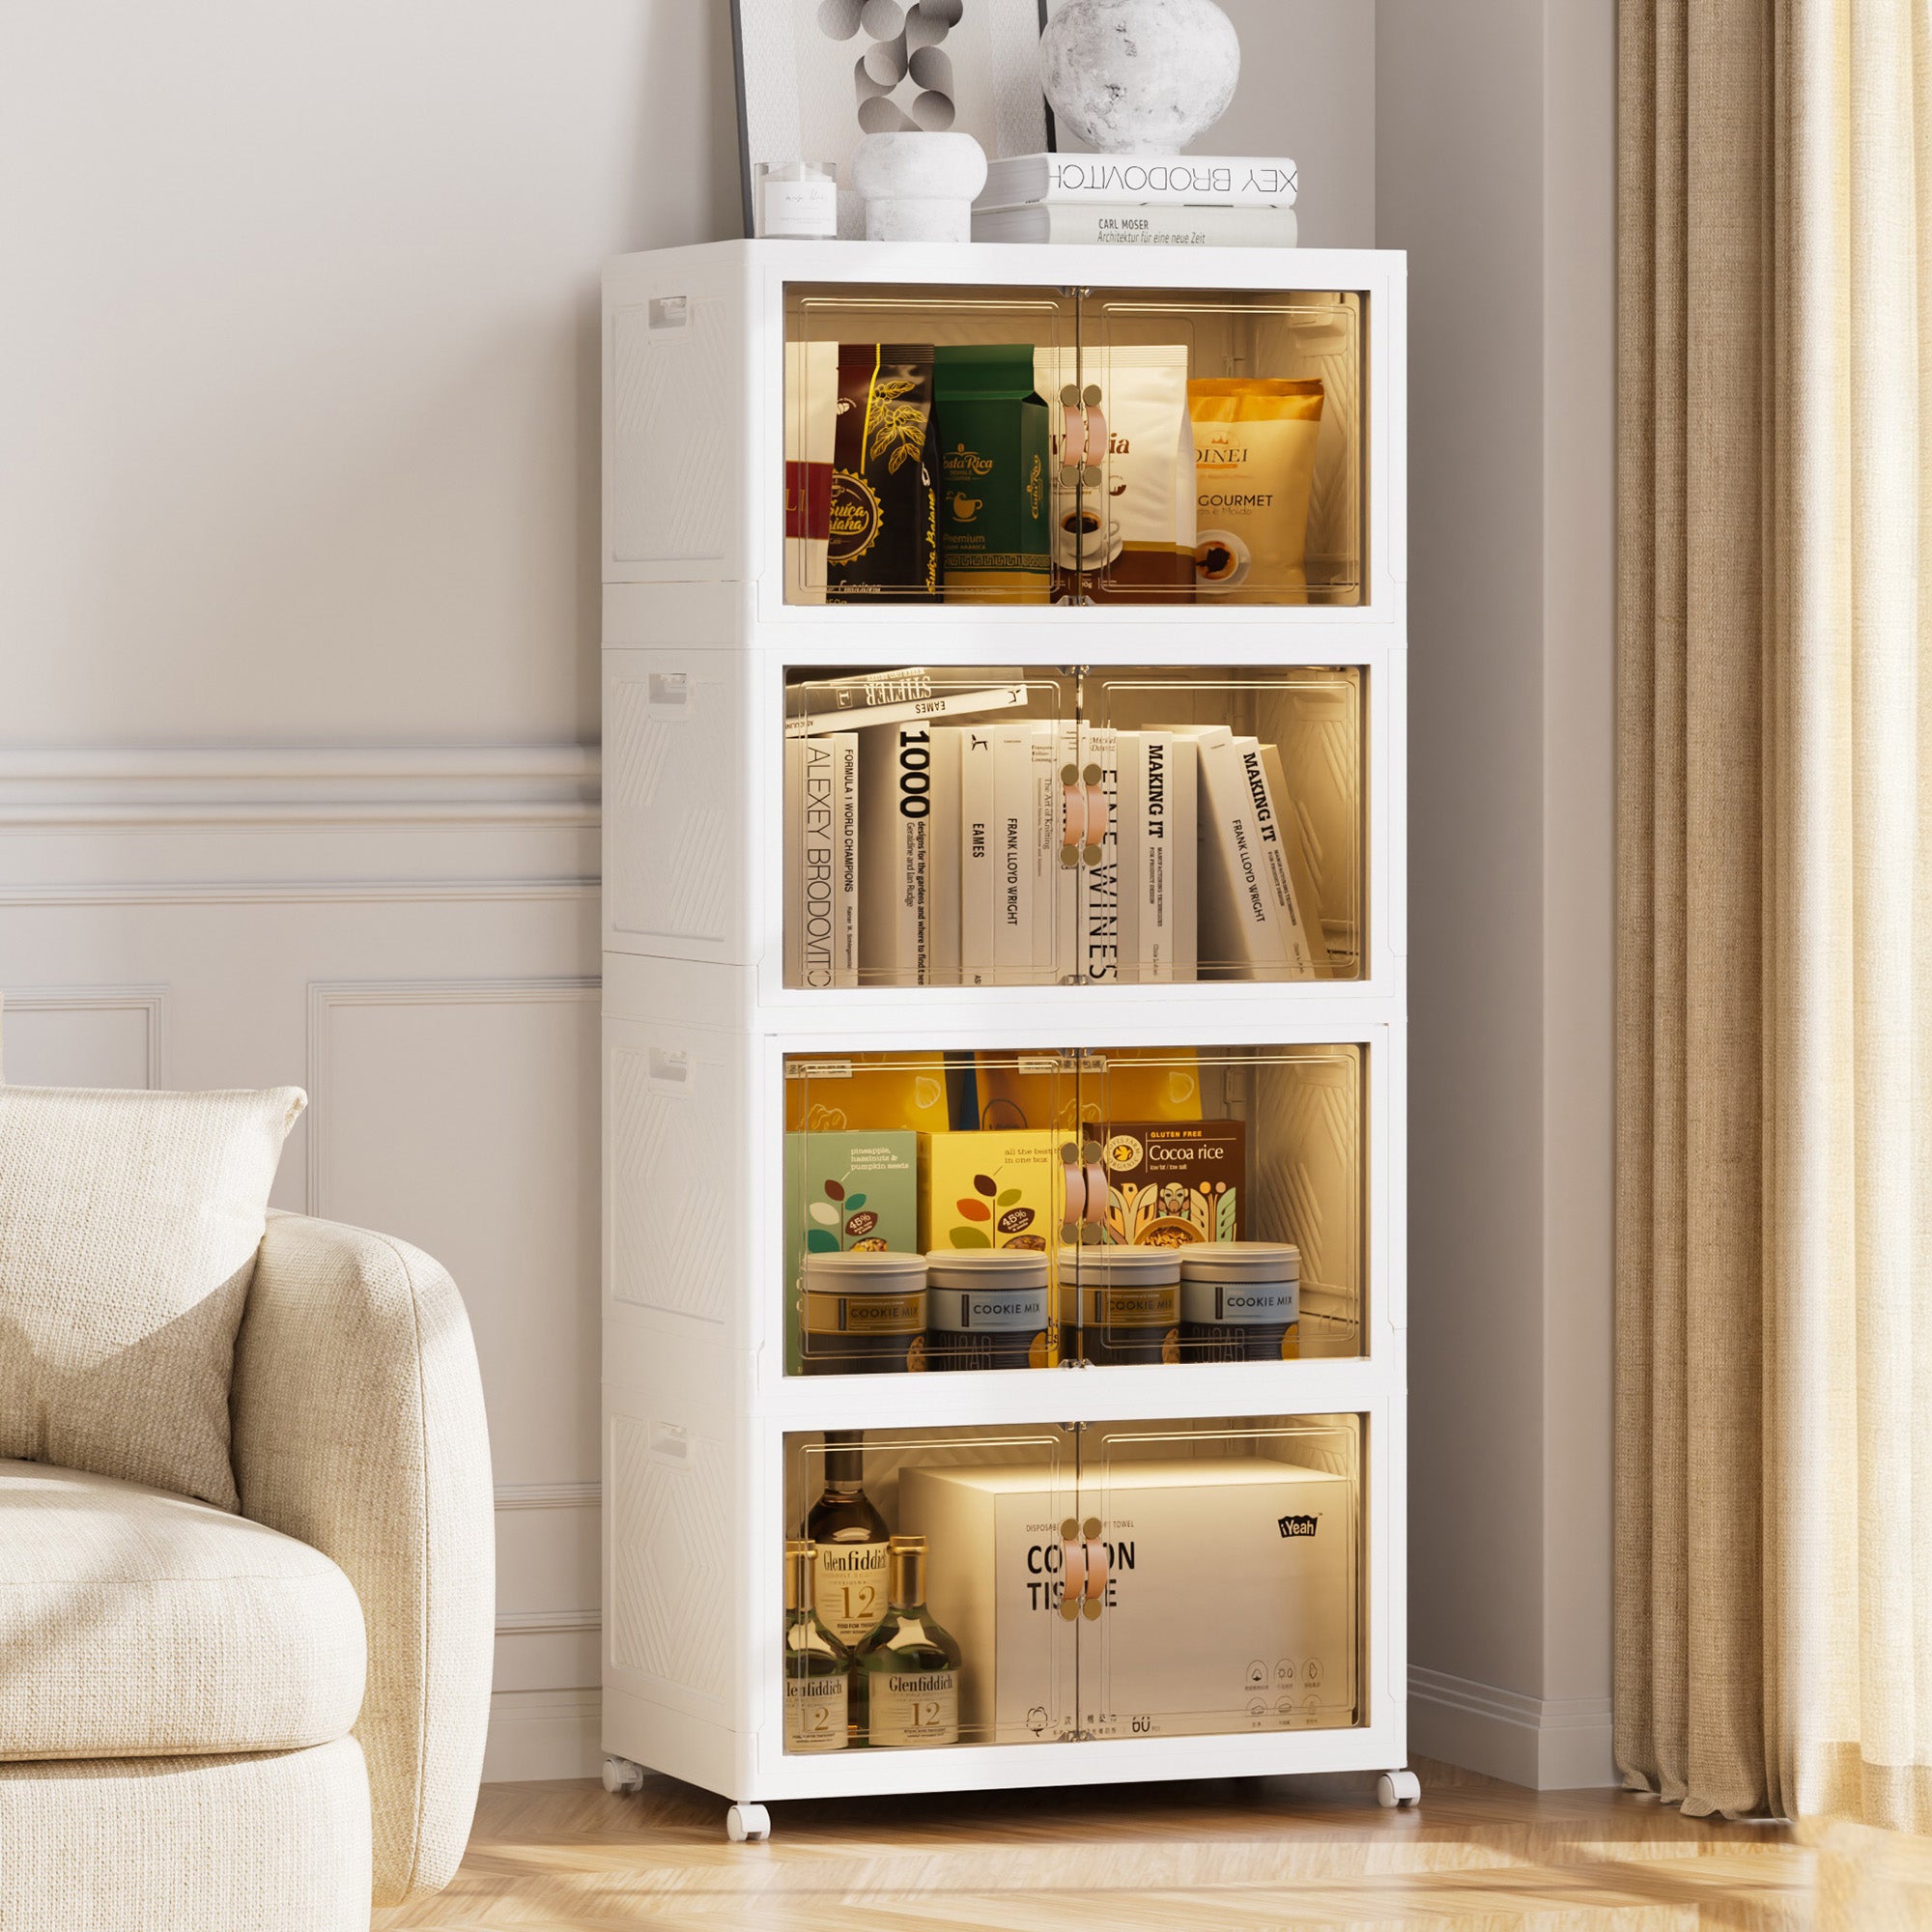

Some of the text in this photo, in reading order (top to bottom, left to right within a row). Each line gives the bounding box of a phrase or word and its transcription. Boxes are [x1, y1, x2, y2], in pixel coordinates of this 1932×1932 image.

[1098, 218, 1149, 230] CARL MOSER
[1097, 230, 1206, 244] Architektur für eine neue Zeit
[943, 457, 966, 469] osta
[964, 454, 993, 475] Rica
[1198, 495, 1273, 506] GOURMET
[865, 675, 932, 706] STIFTER
[915, 700, 946, 714] EAMES
[844, 749, 854, 793] FORMULA
[899, 730, 930, 818] 1000
[807, 747, 831, 840] ALEXEY
[1148, 745, 1164, 838] MAKING IT
[1242, 752, 1277, 842] MAKING IT
[844, 803, 854, 837] WORLD
[916, 821, 926, 849] designs
[973, 823, 984, 858] EAMES
[844, 838, 854, 893] CHAMPIONS
[906, 857, 915, 870] and
[917, 850, 926, 861] for
[917, 862, 926, 875] the
[1007, 818, 1018, 925] FRANK LLOYD WRIGHT
[1232, 819, 1265, 923] FRANK LLOYD WRIGHT
[904, 884, 915, 907] Rudge
[915, 875, 926, 904] gardens
[917, 905, 926, 920] and
[1089, 863, 1118, 980] WINES
[917, 921, 925, 943] where
[917, 953, 926, 968] find
[1150, 1145, 1224, 1160] Cocoa rice
[1003, 1209, 1027, 1226] 45%
[974, 1303, 1040, 1315] COOKIE MIX
[1227, 1295, 1293, 1307] COOKIE MIX
[850, 1306, 899, 1319] COOKIE
[1280, 1520, 1315, 1536] iYeah
[840, 1585, 875, 1619] 12
[889, 1674, 953, 1692] Glenfiddich
[801, 1707, 830, 1732] 12
[912, 1701, 941, 1726] 12
